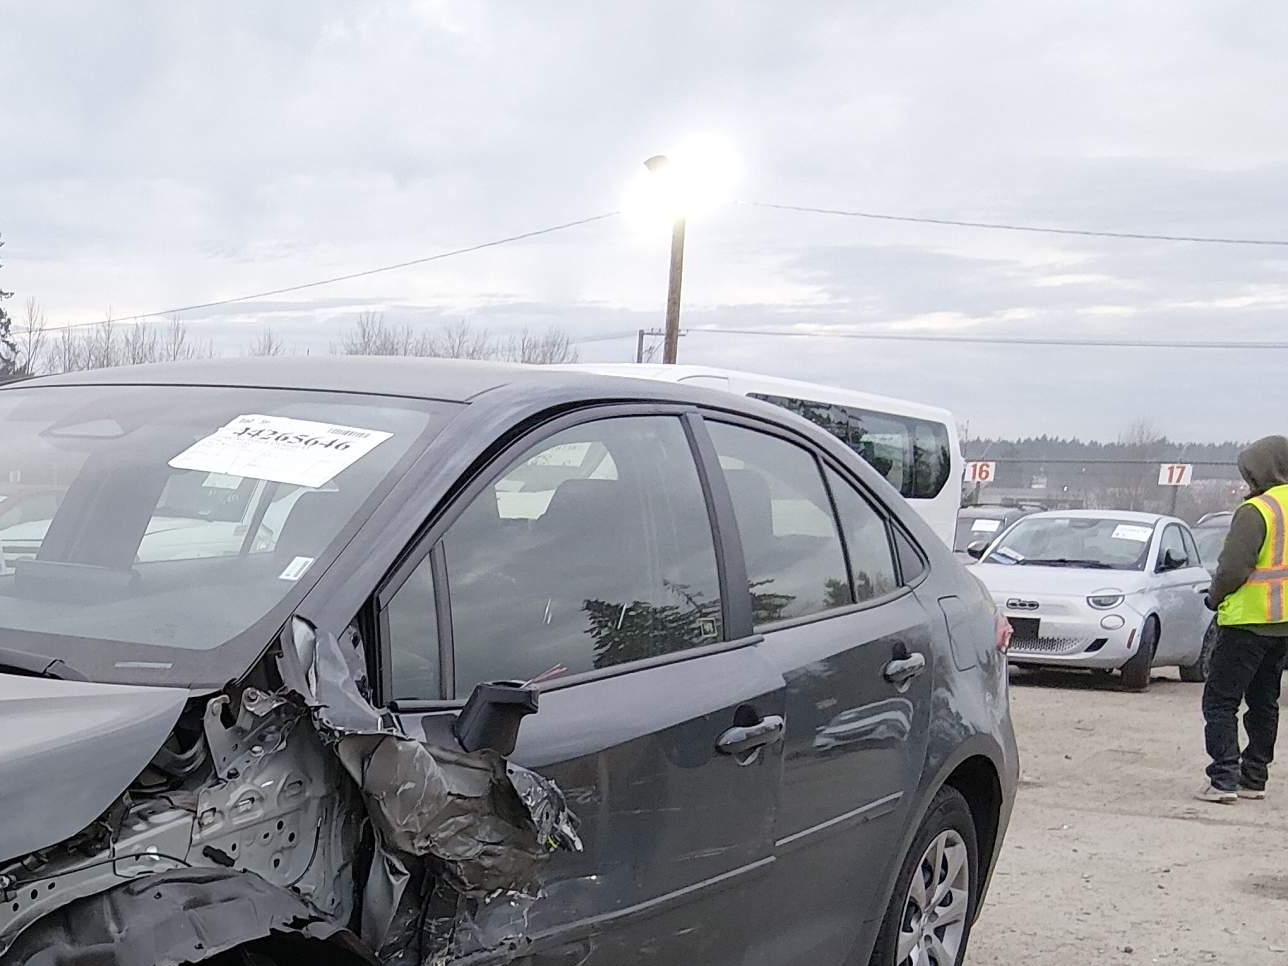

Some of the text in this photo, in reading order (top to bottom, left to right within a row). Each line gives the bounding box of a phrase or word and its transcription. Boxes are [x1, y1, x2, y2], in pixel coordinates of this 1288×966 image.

[233, 427, 350, 450] 44265646
[971, 463, 990, 481] 16
[1167, 465, 1187, 483] 17
